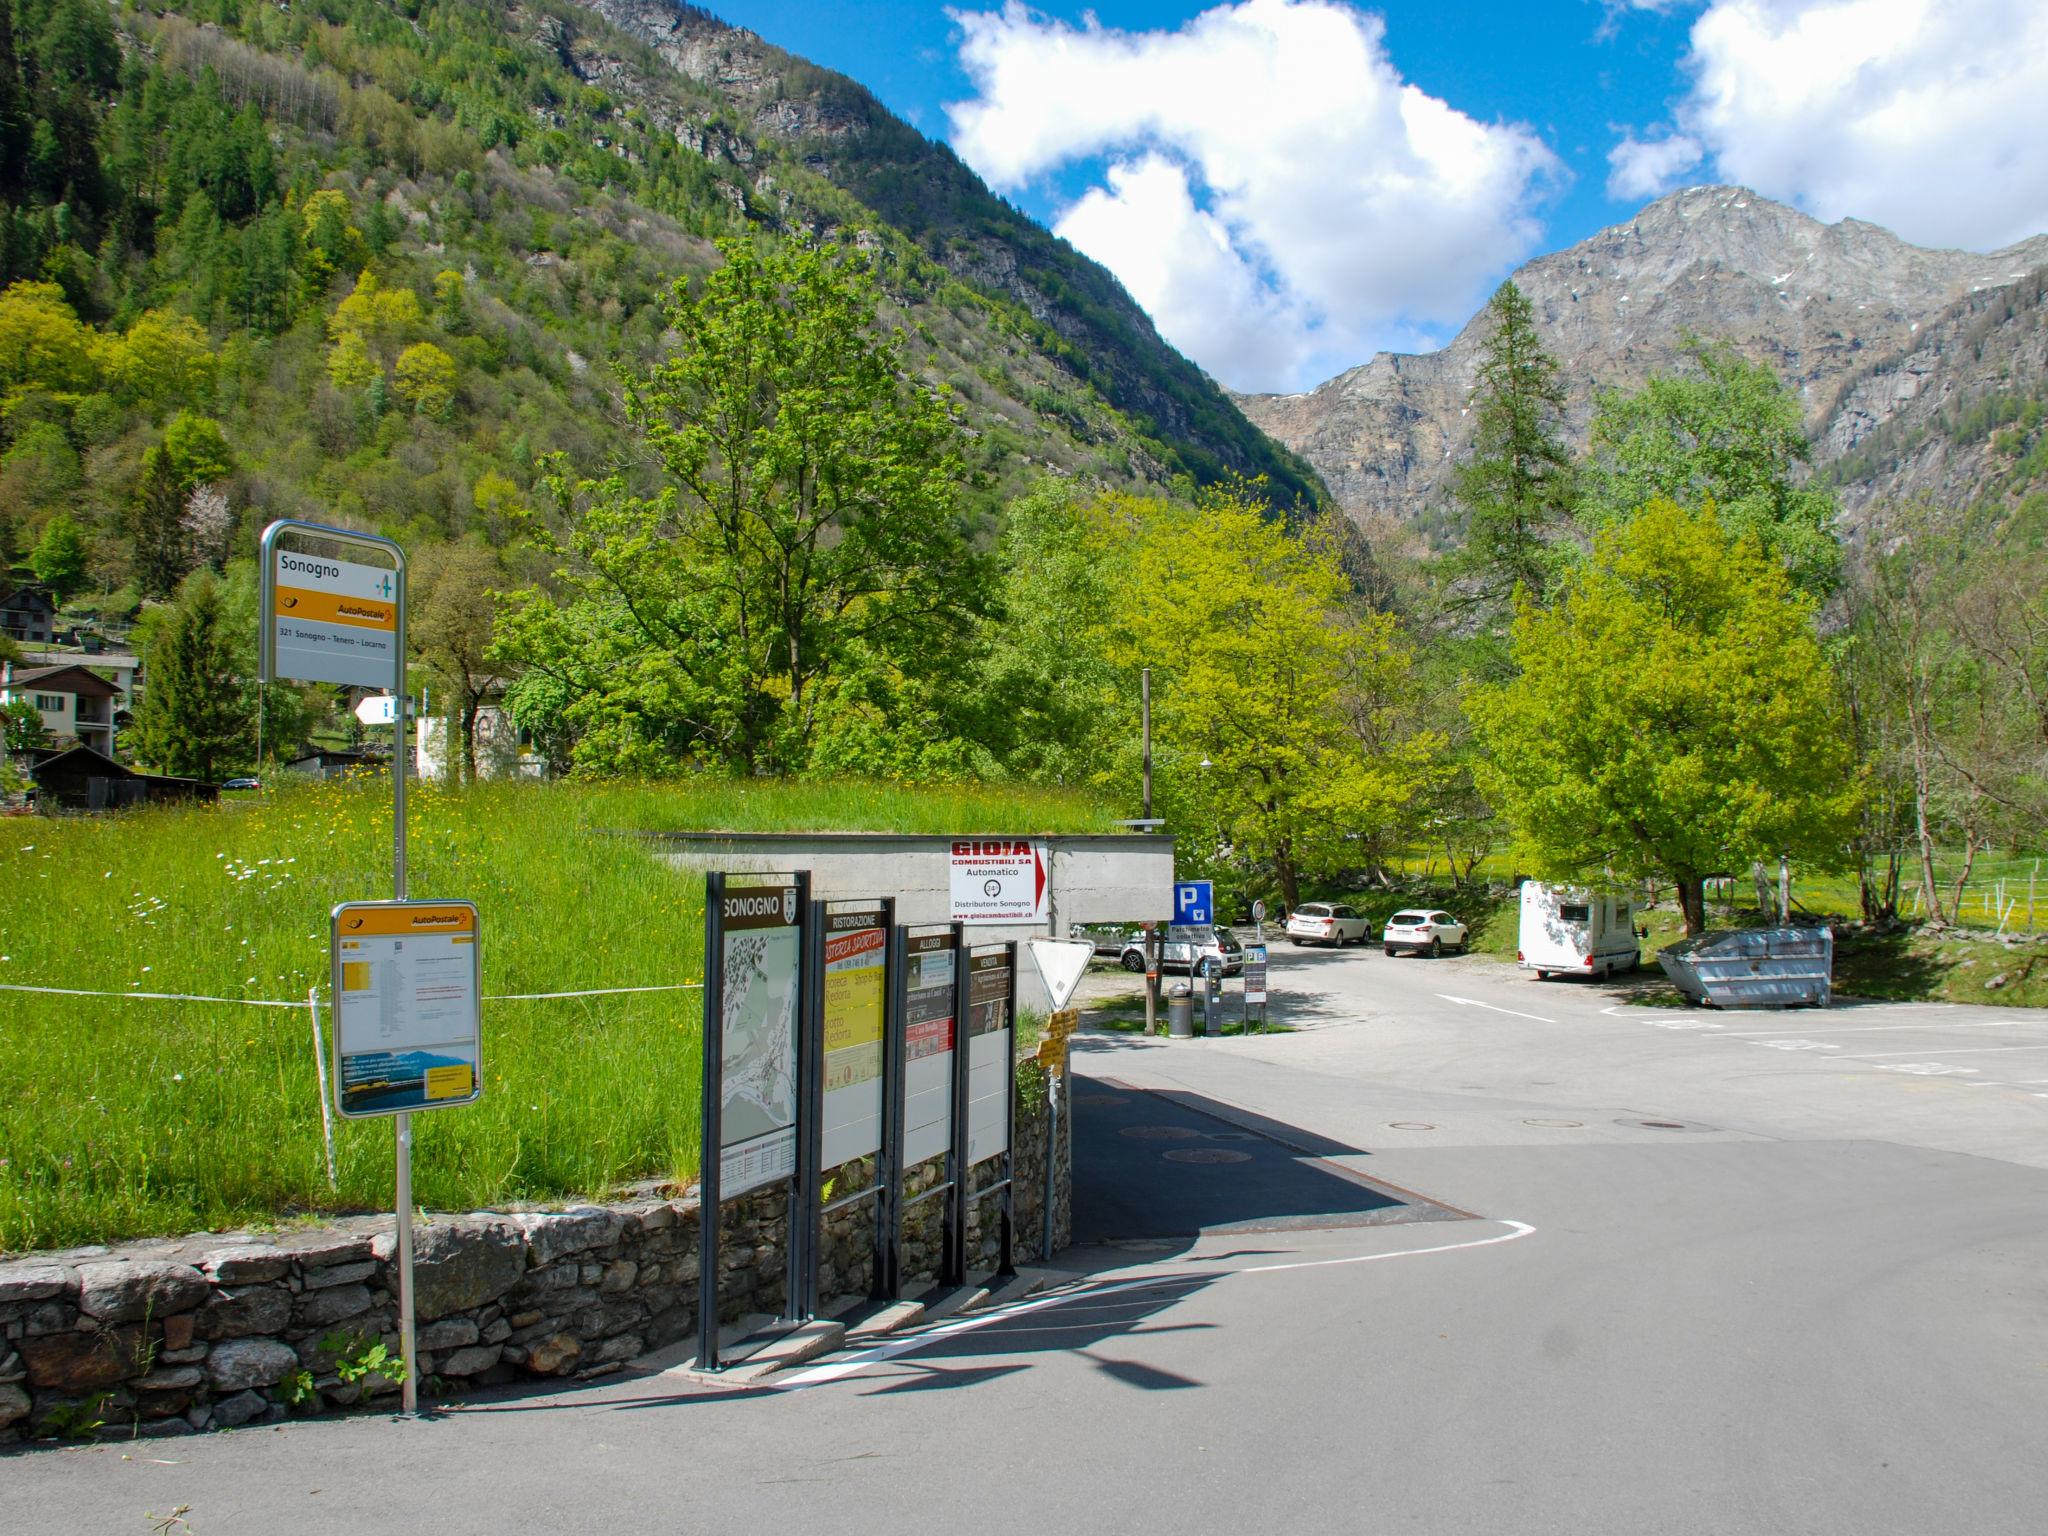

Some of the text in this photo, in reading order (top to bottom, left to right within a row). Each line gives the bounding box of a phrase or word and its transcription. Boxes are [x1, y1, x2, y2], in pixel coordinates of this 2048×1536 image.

[281, 555, 340, 579] Sonogno
[338, 604, 385, 620] AutoPostale
[279, 627, 292, 637] 321
[295, 630, 326, 642] Sonogno
[333, 635, 355, 645] Tenero
[361, 639, 387, 650] Locarno
[951, 841, 1032, 856] GIOIA
[966, 868, 1019, 877] Automatico
[724, 896, 780, 918] SONOGNO
[999, 900, 1031, 908] Sonogno
[1180, 887, 1198, 913] P
[412, 914, 460, 925] AutoPostale
[832, 914, 876, 929] RISTORAZIONE
[952, 911, 1033, 920] www.gioiacombustibili.ch
[919, 938, 941, 950] ALLOGGI
[980, 956, 998, 968] VENDITA
